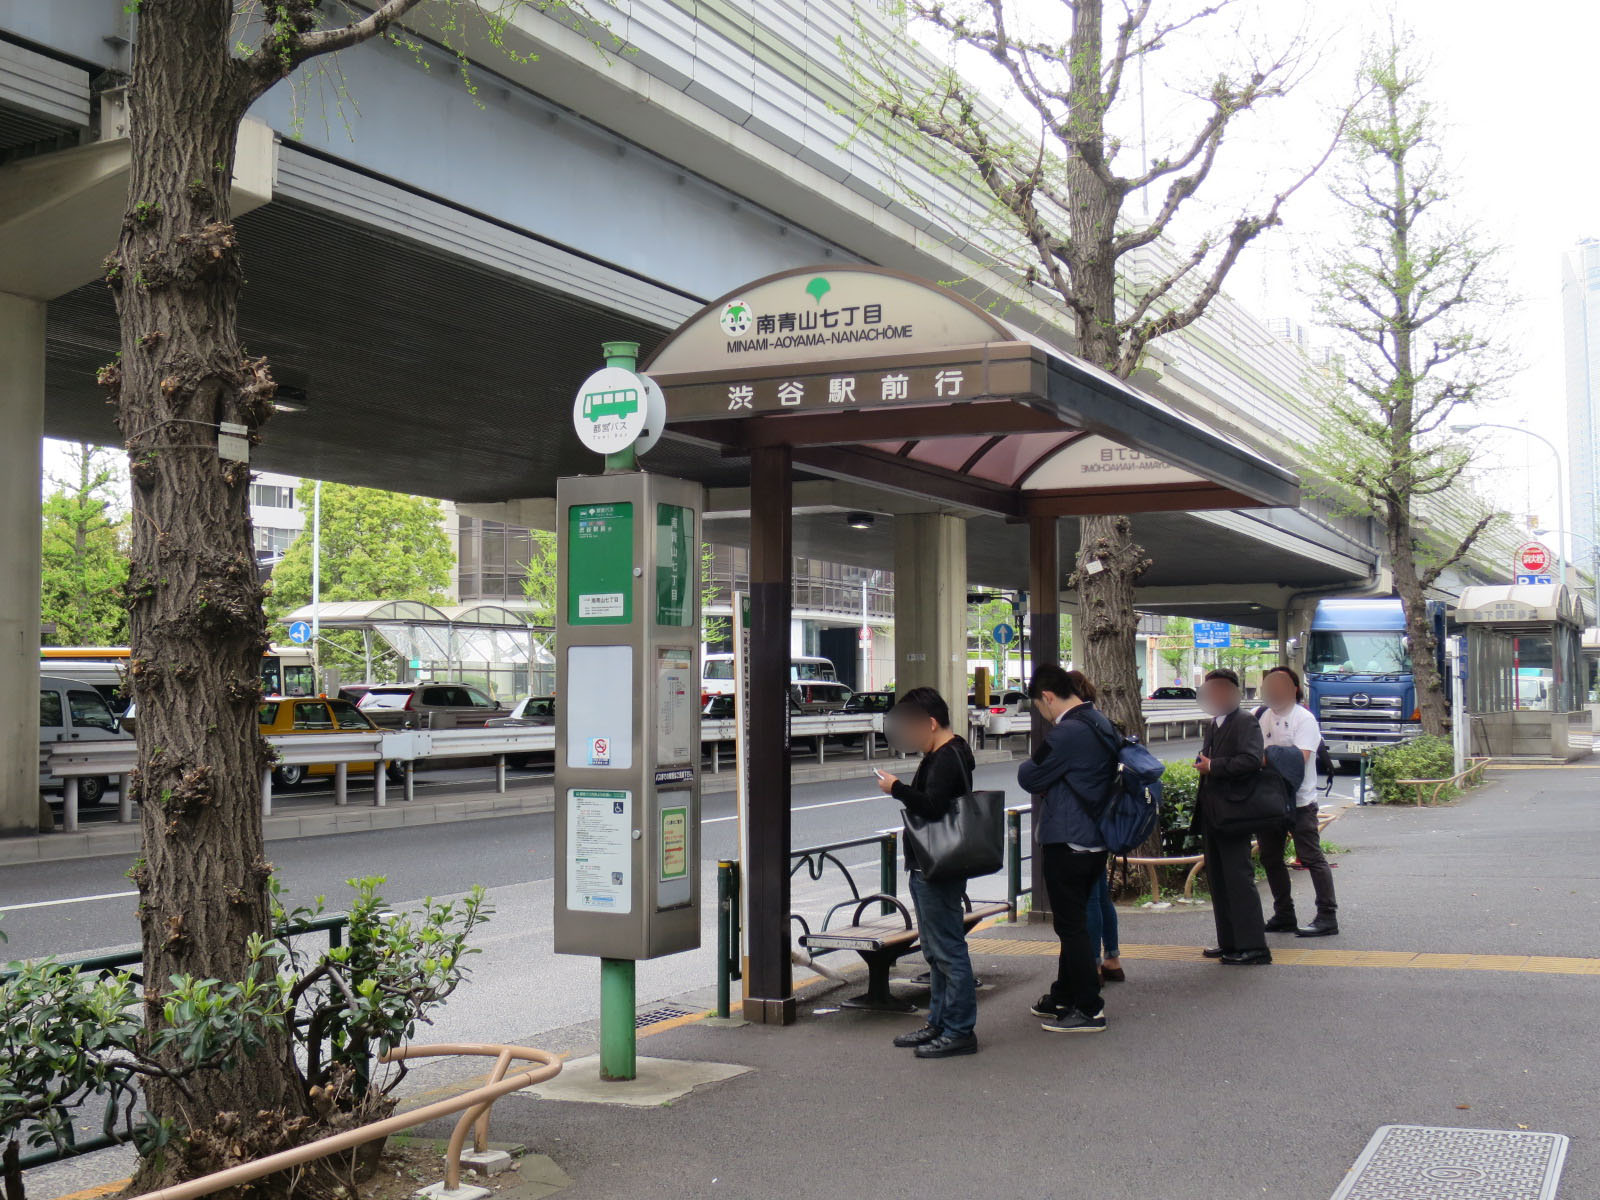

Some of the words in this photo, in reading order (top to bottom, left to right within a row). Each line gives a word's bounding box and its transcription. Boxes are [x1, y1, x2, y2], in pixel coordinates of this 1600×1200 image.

[756, 304, 883, 335] 南青山七丁目
[727, 324, 913, 354] MINAMI-AOYAMA-NANACHŌME
[728, 370, 964, 411] 渋谷駅前行
[593, 422, 628, 434] 都営バス
